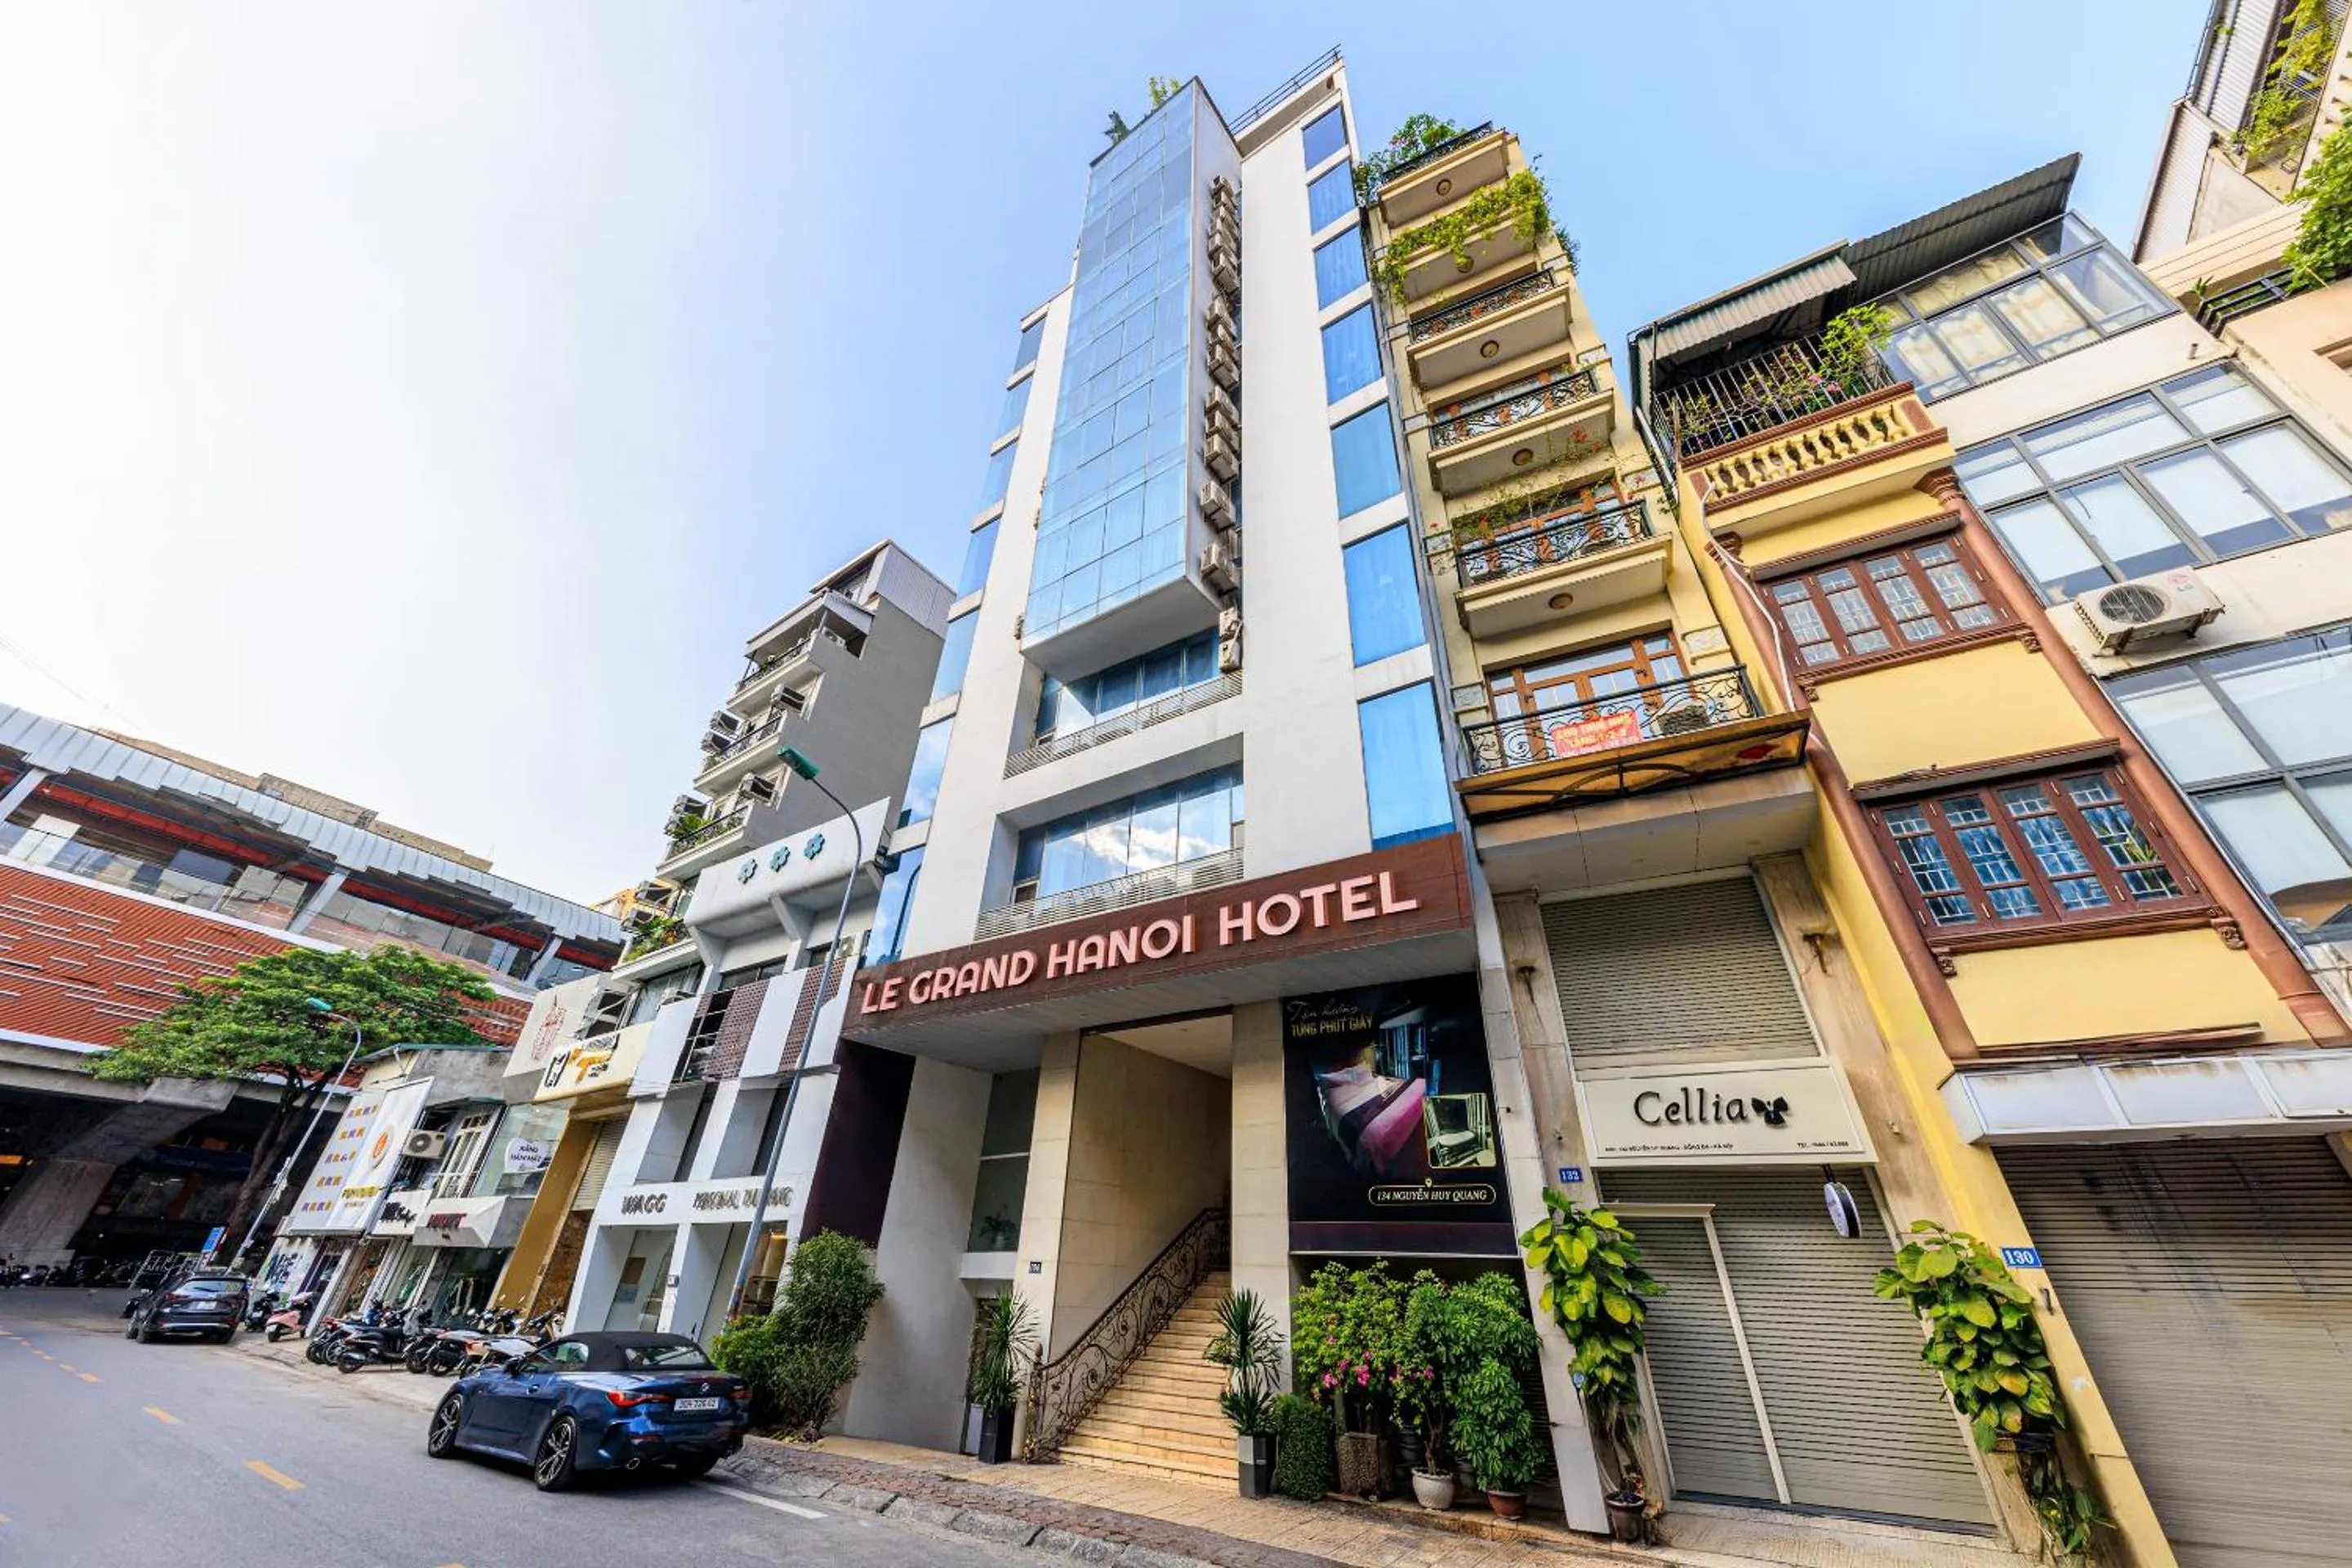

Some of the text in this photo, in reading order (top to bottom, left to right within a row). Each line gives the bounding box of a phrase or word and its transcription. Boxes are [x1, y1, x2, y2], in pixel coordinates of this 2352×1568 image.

[861, 871, 1419, 1013] LE GRAND HANOI HOTEL
[1634, 1086, 1748, 1126] Cellia
[1453, 1190, 1487, 1201] QUANG
[2005, 1250, 2034, 1264] 130
